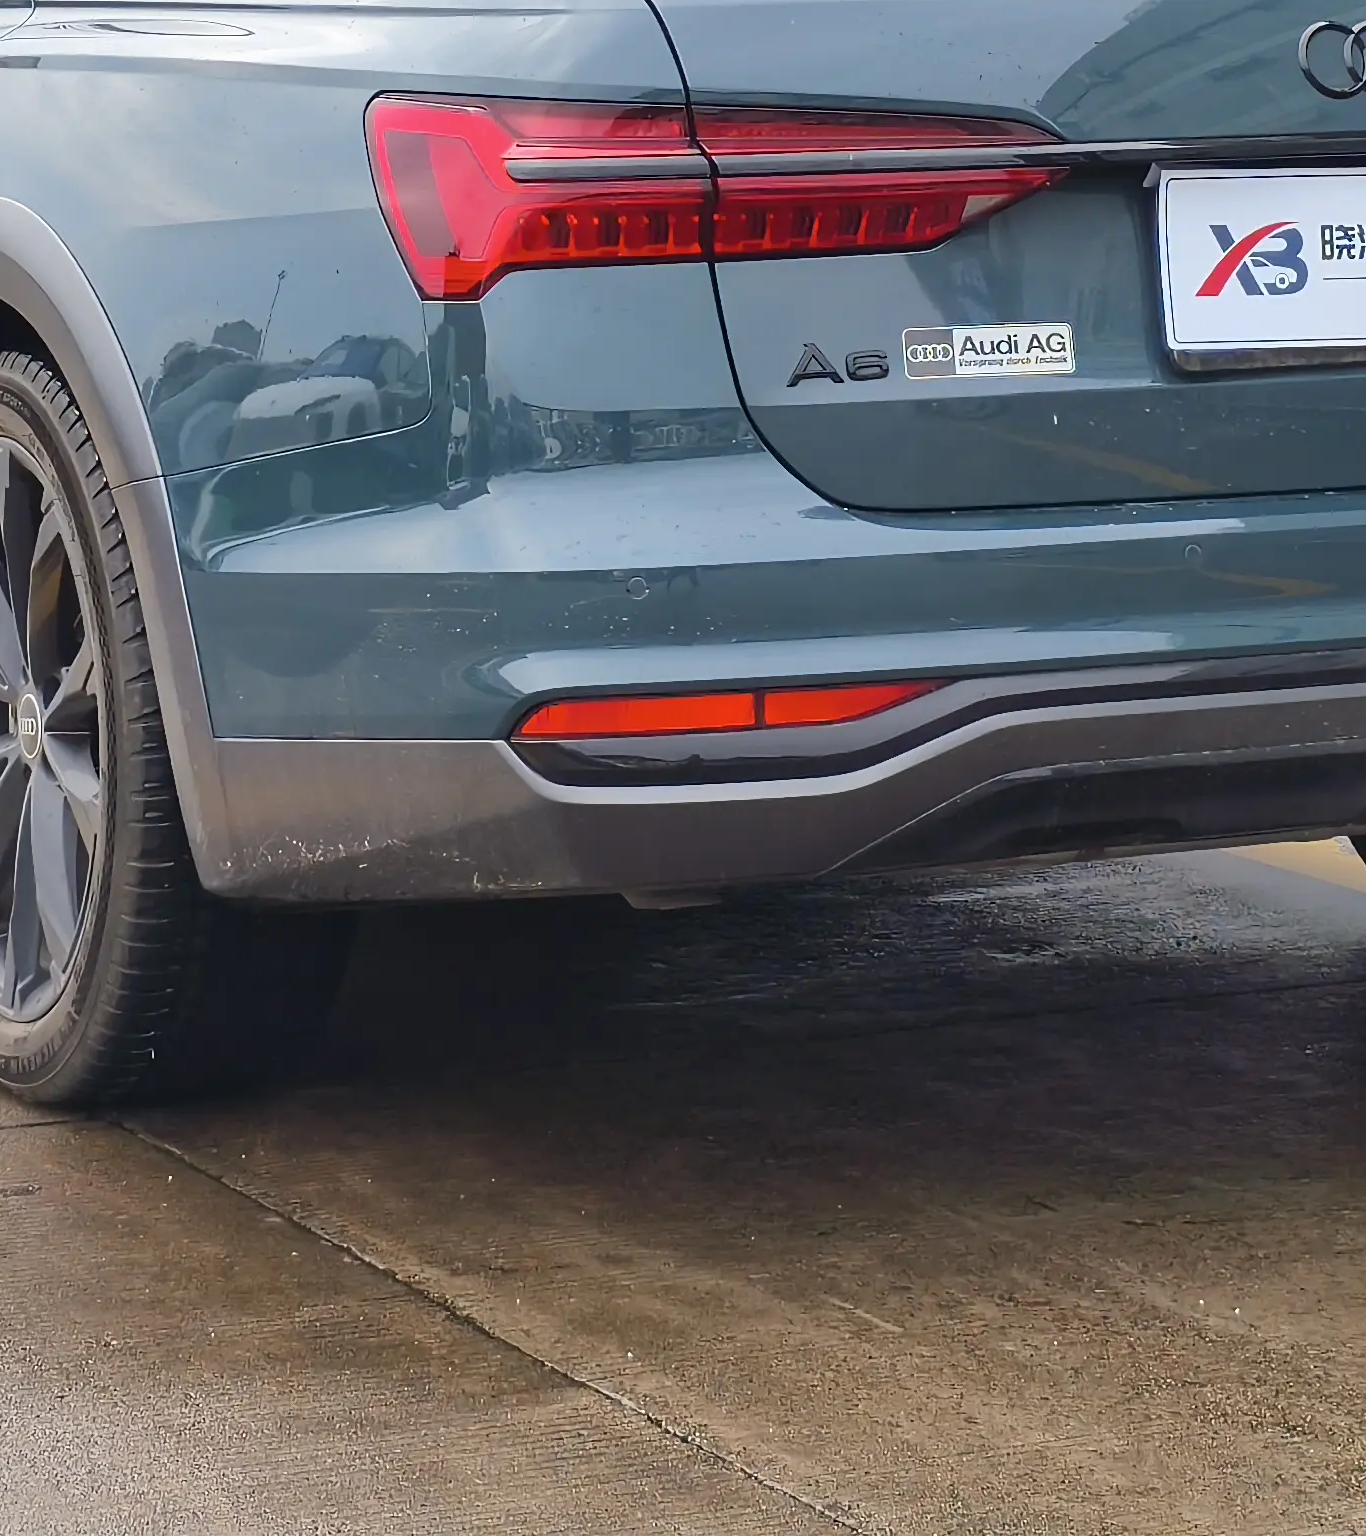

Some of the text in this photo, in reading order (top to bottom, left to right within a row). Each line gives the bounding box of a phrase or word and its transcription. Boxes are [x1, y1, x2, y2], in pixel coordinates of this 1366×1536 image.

[957, 331, 1067, 358] Audi AG
[786, 342, 890, 388] A6
